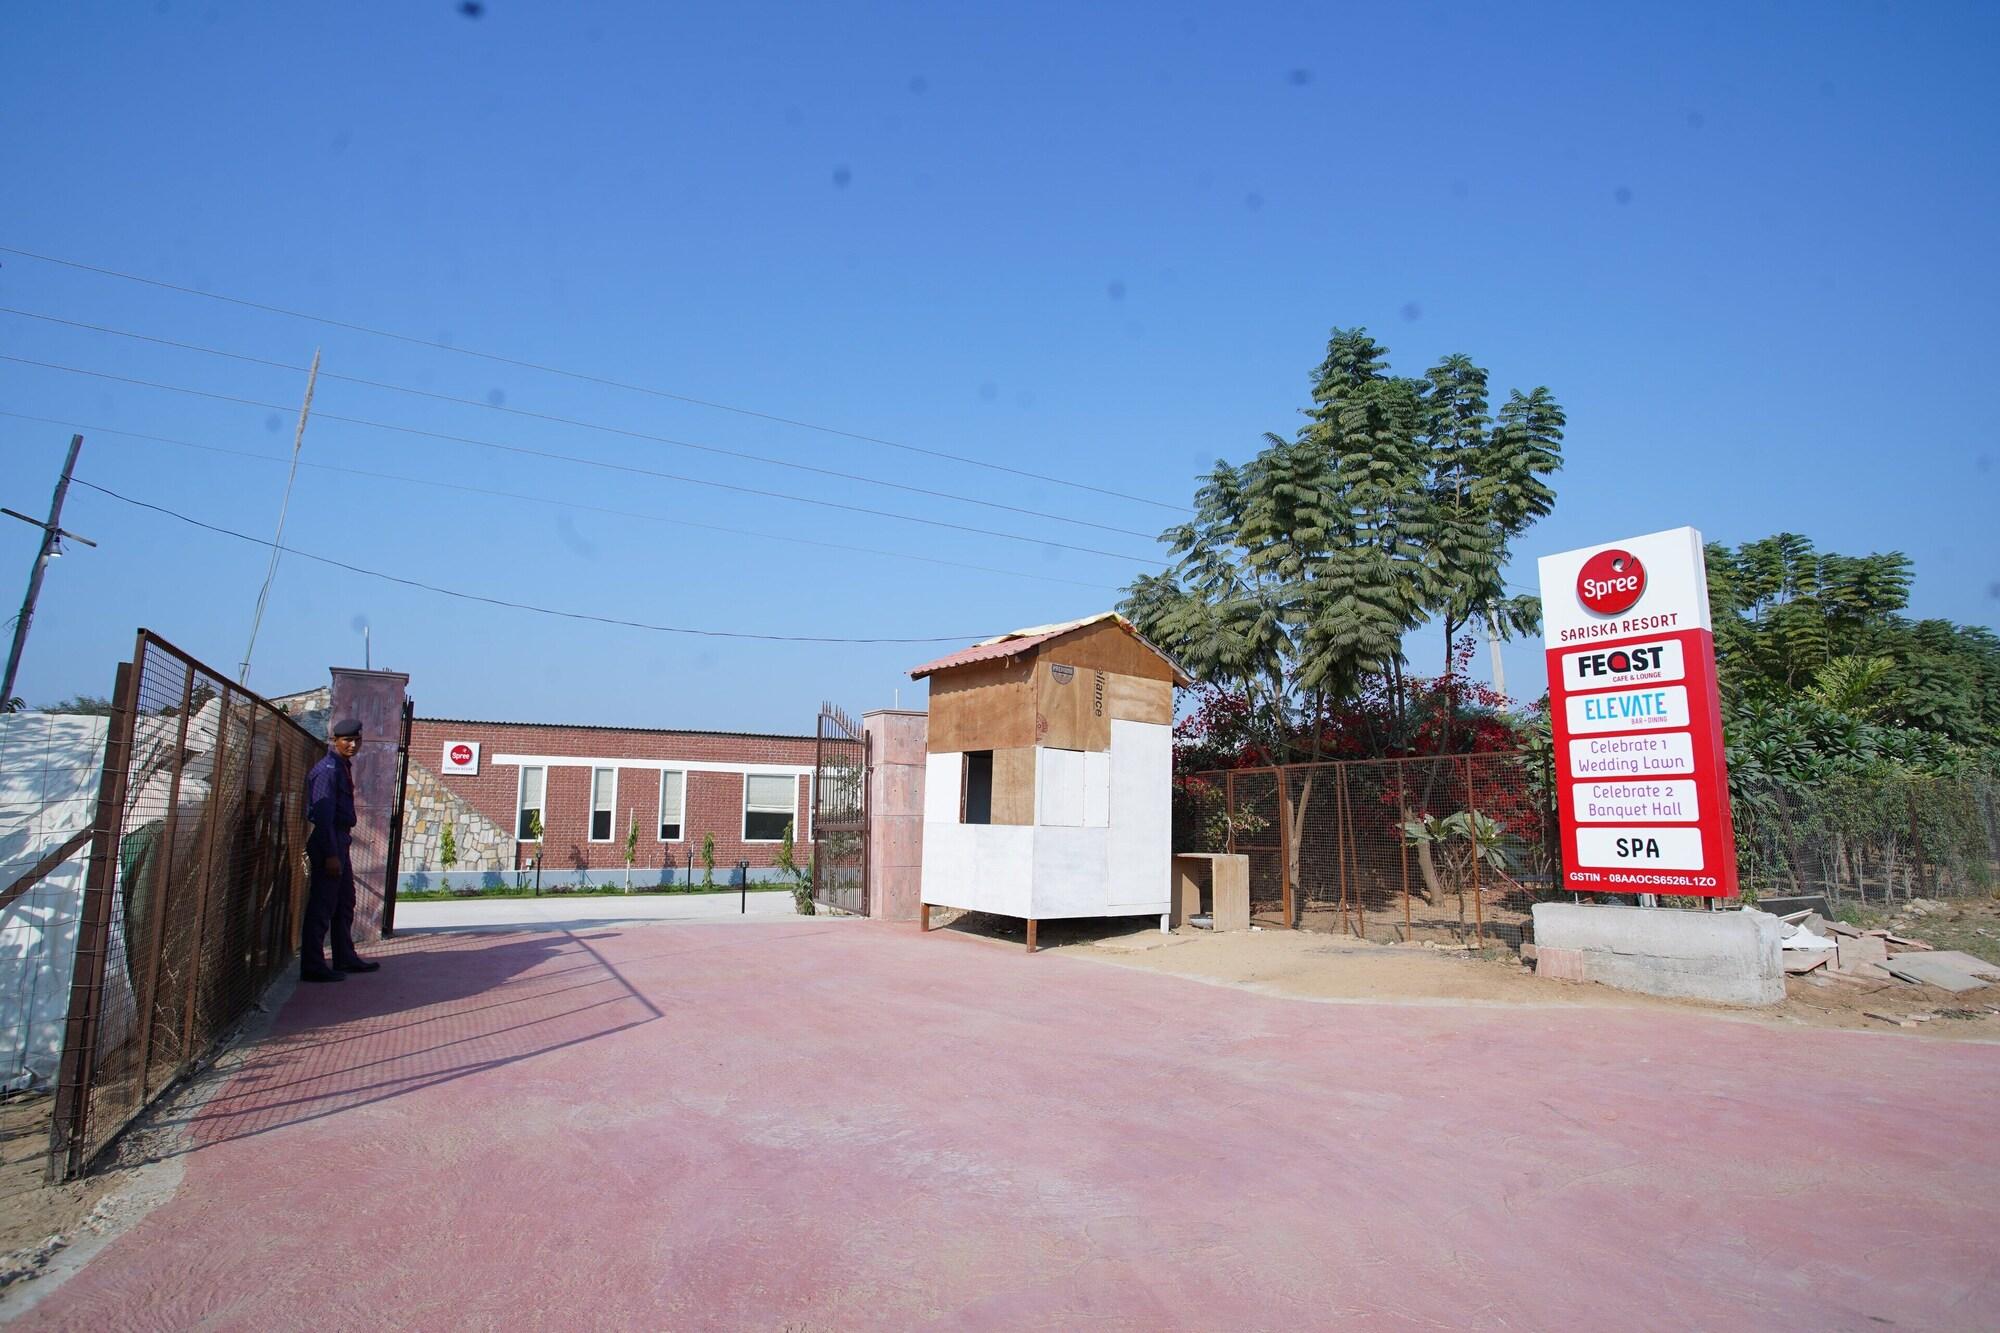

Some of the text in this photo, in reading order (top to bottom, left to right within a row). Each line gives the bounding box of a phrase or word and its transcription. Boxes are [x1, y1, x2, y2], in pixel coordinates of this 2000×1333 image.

[1583, 575, 1638, 600] Spree
[1560, 613, 1678, 642] SARISKA RESORT
[1578, 646, 1664, 678] FEAST
[1612, 674, 1629, 683] CAFE
[1636, 671, 1662, 680] LOUNGE
[1095, 668, 1105, 717] eliance
[1585, 692, 1667, 721] ELEVATE
[1631, 717, 1643, 725] BAR
[1647, 715, 1668, 724] DINING
[1590, 739, 1667, 754] Celebrate 1
[451, 752, 470, 760] Spree
[1578, 756, 1685, 773] Wedding Lawn
[1593, 784, 1674, 799] Celebrate 2
[1589, 801, 1682, 819] Banquet Hall
[1616, 837, 1660, 858] SPA
[1569, 872, 1601, 882] GSTIN
